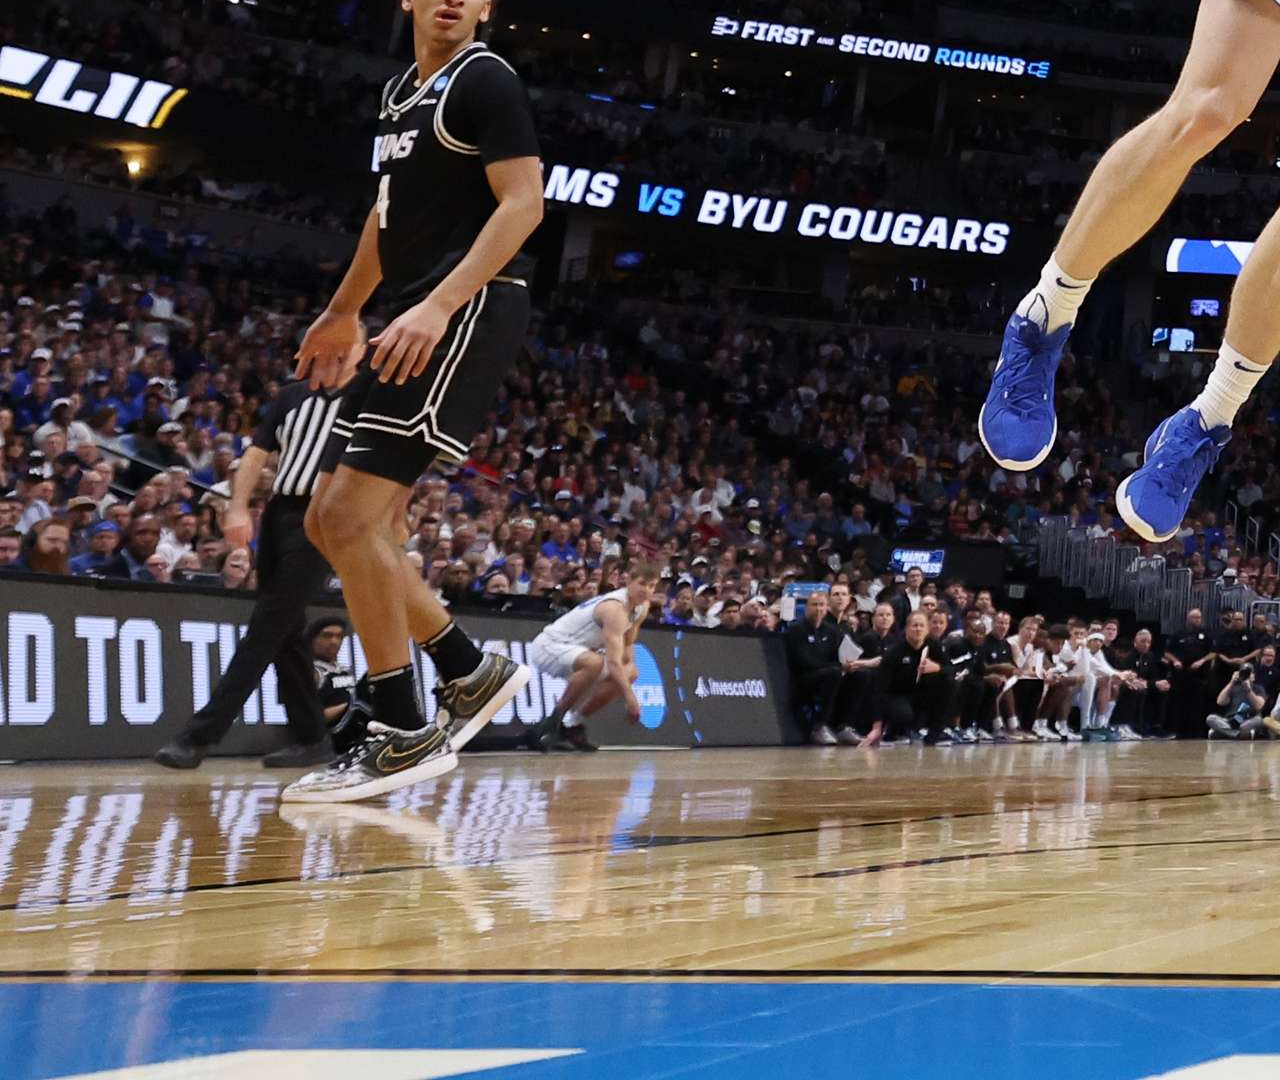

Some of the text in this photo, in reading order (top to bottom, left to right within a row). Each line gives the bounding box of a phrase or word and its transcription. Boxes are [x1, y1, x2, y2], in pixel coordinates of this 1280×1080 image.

[740, 20, 815, 47] FIRST
[838, 34, 931, 63] SECOND
[934, 47, 1026, 76] ROUNDS
[635, 183, 685, 217] VS
[697, 189, 787, 233] BYU
[797, 203, 1010, 255] COUGARS
[74, 616, 164, 726] TO
